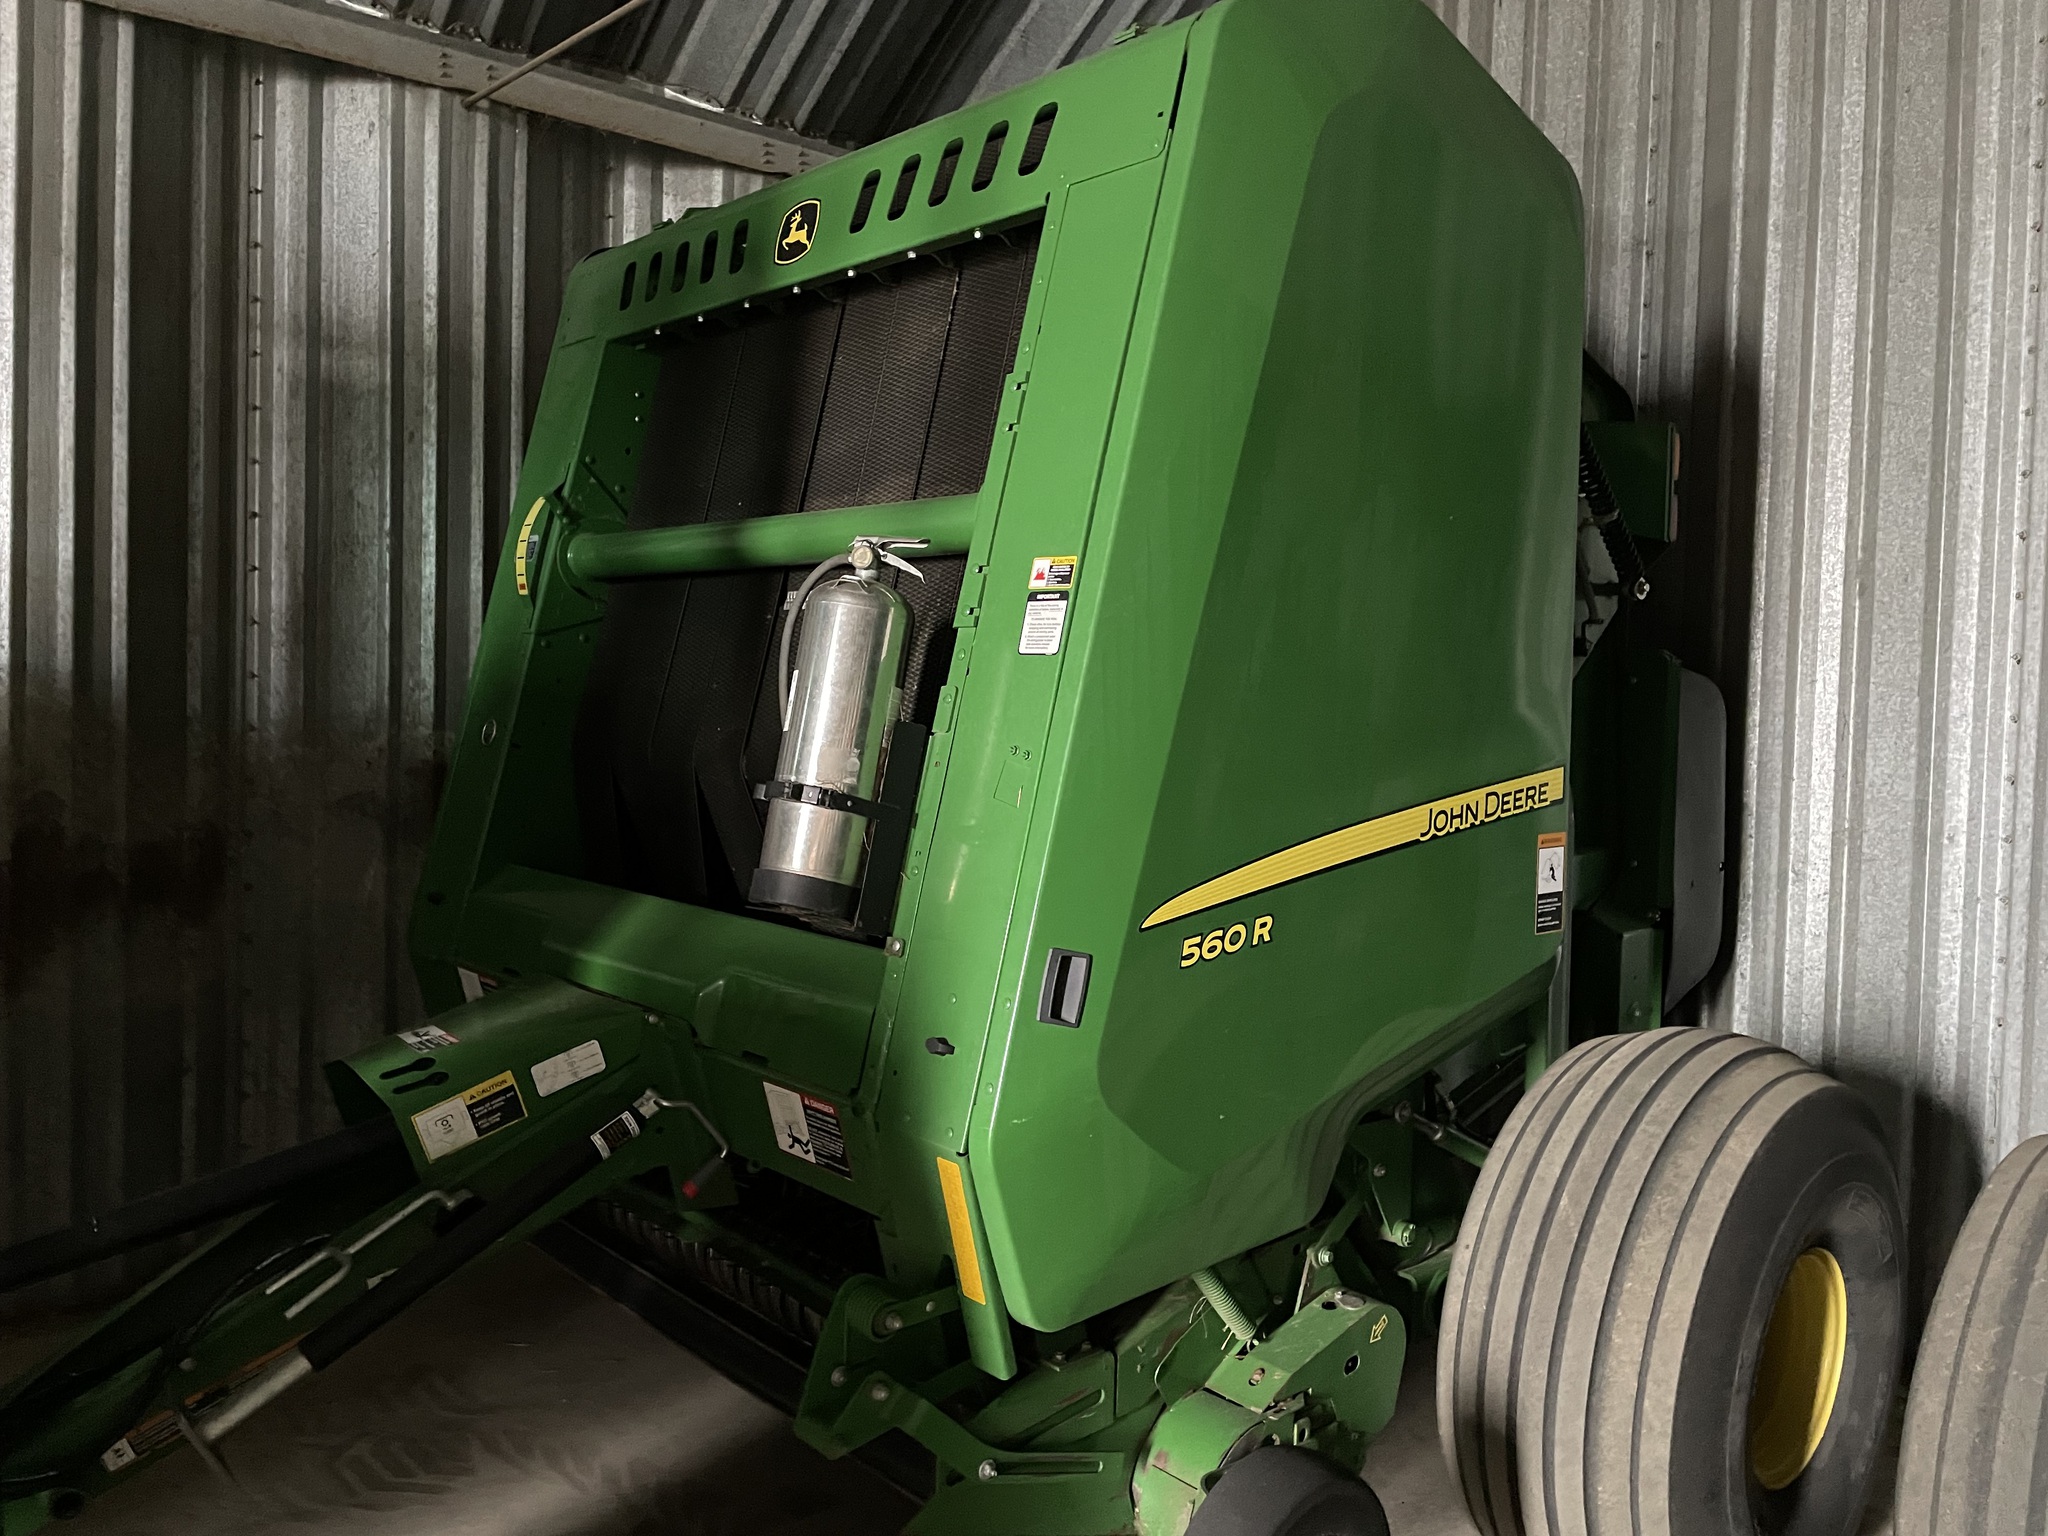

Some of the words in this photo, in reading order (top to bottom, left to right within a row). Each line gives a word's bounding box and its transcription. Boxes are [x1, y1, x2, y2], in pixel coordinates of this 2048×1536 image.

[1420, 800, 1479, 838] JOHN
[1484, 783, 1549, 819] DEERE
[1180, 922, 1247, 968] 560
[1252, 915, 1273, 946] R
[477, 1079, 507, 1097] CAUTION
